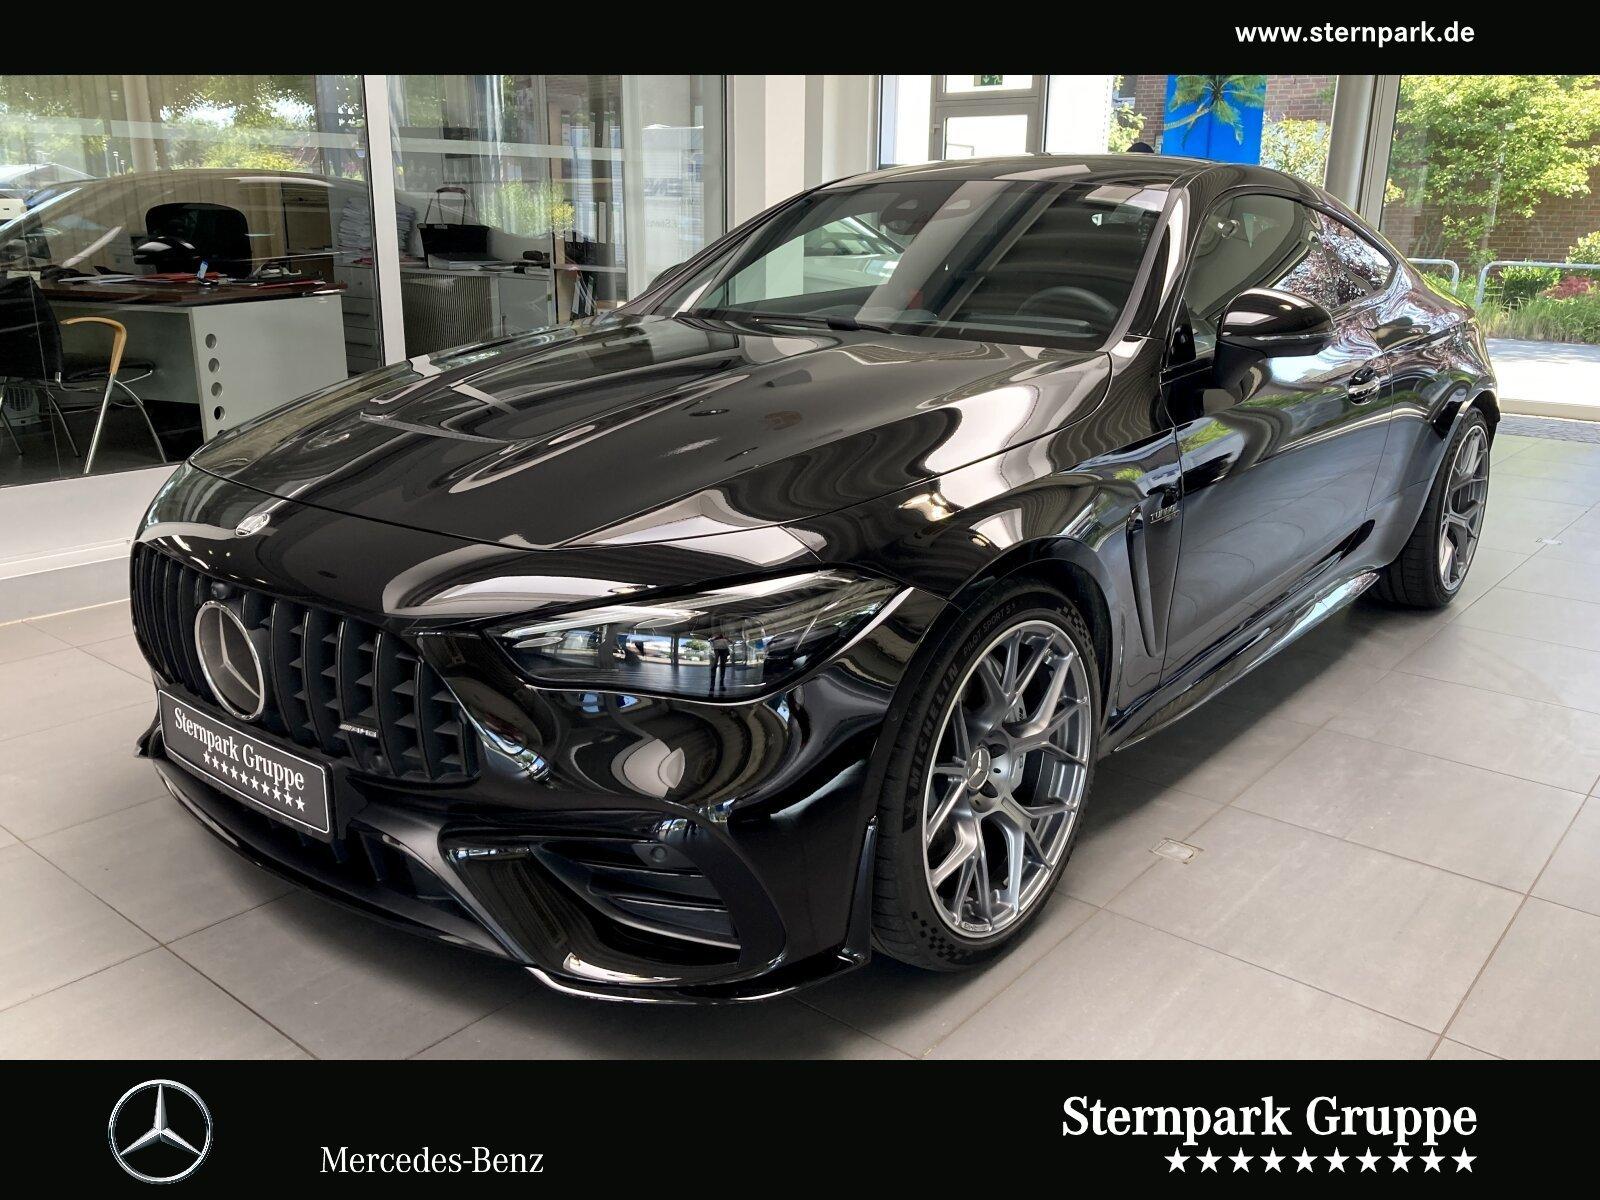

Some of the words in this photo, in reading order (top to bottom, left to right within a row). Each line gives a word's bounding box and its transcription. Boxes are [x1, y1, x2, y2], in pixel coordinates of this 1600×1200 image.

[963, 629, 982, 656] PILOT
[982, 608, 1005, 632] SPORT
[174, 707, 240, 761] Sternpark
[242, 744, 305, 790] Gruppe
[910, 663, 959, 790] MICHELIN
